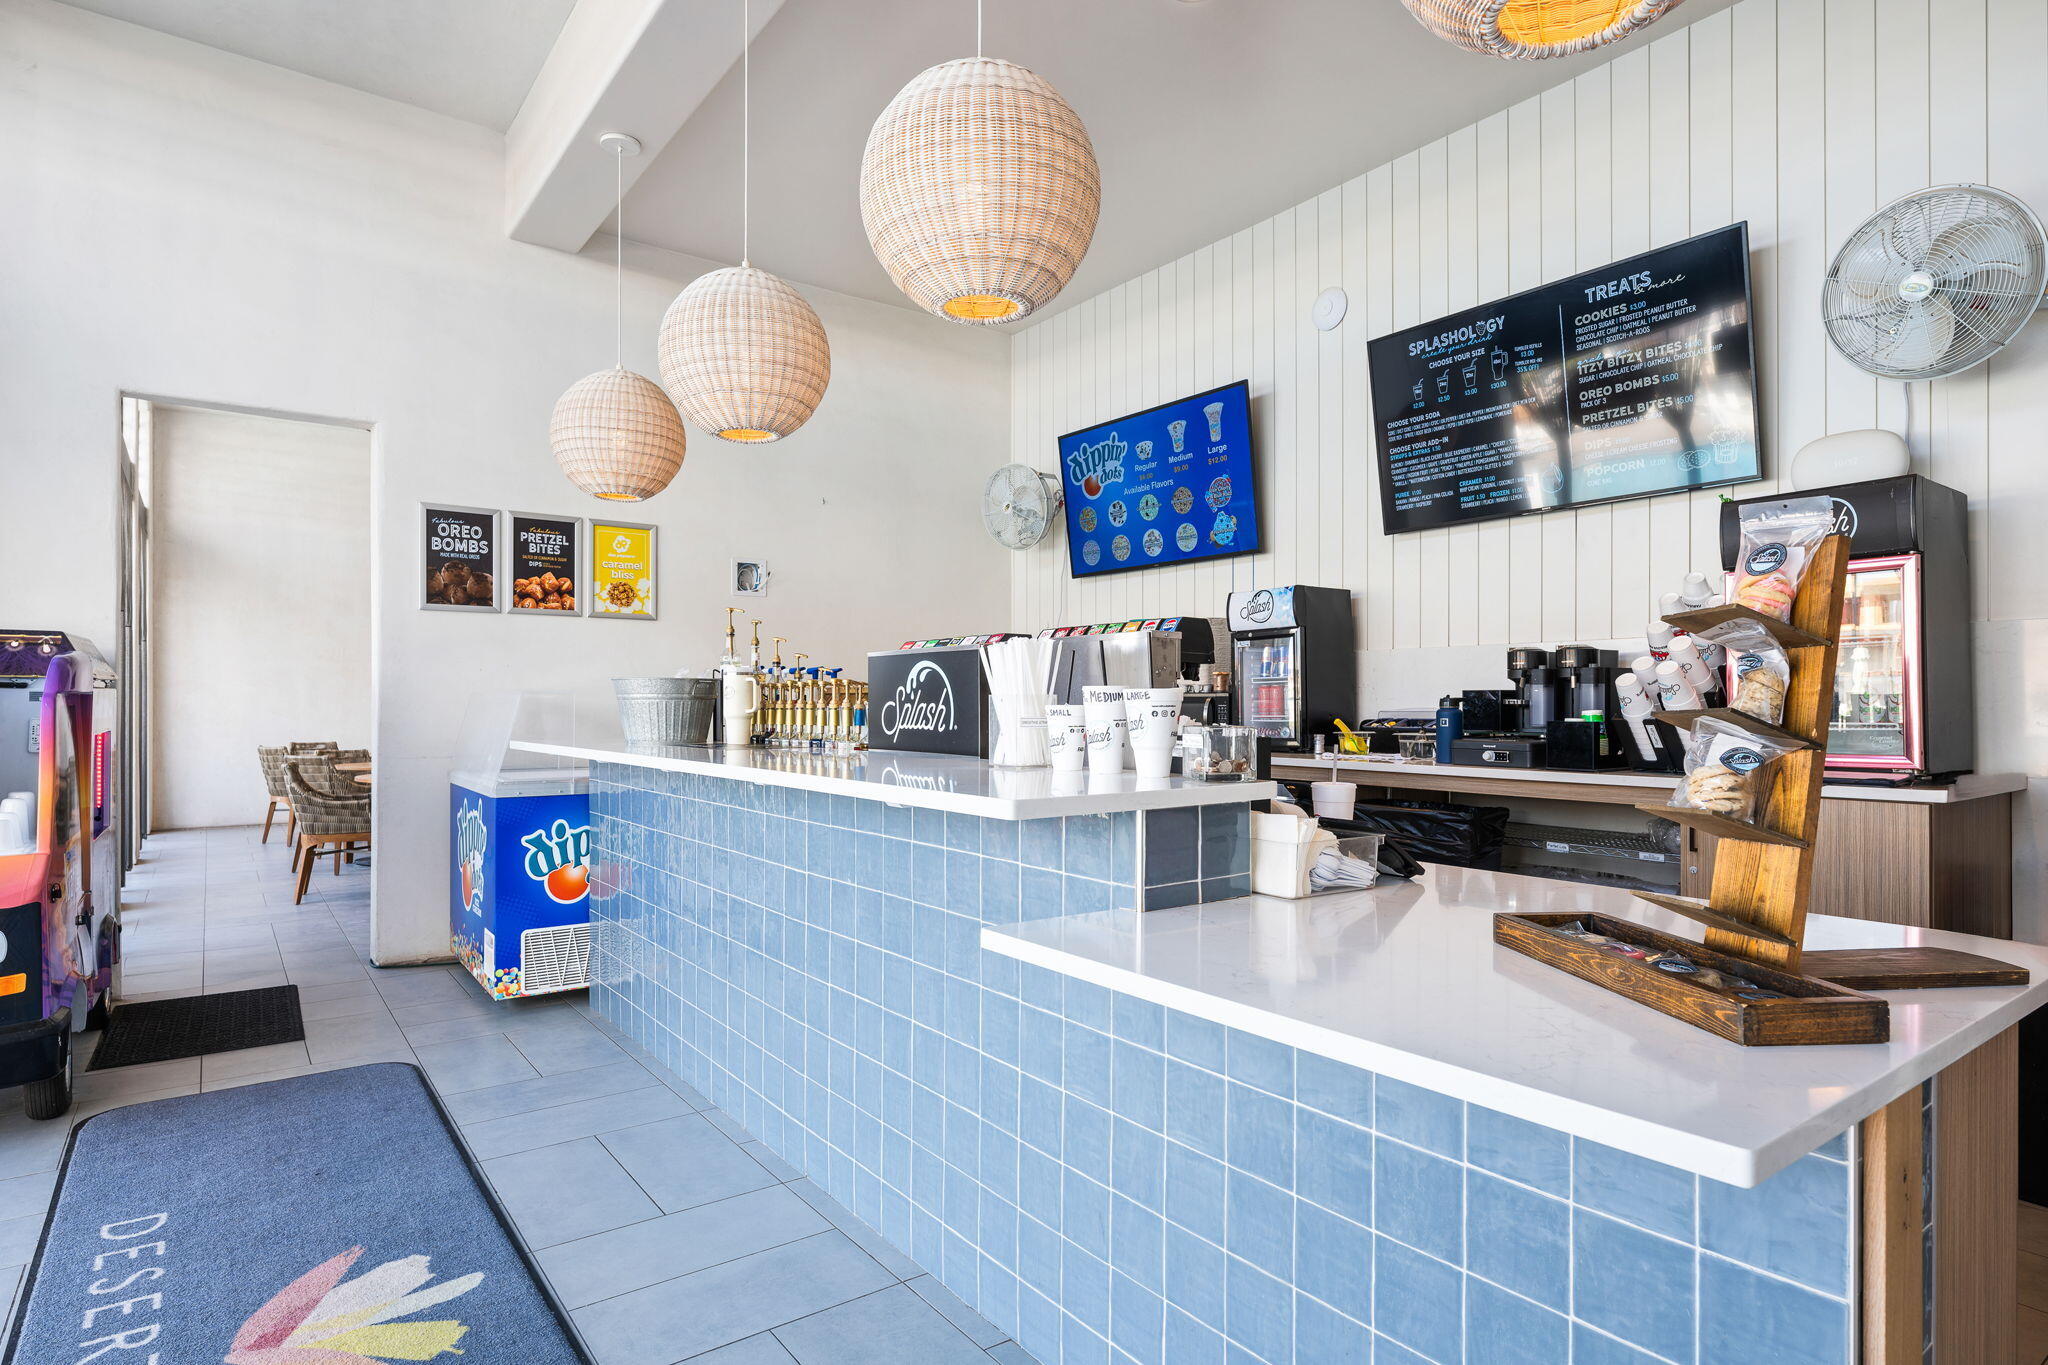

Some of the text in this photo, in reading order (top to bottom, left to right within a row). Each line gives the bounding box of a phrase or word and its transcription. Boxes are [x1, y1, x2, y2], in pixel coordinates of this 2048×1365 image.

[1584, 269, 1652, 304] TREATS
[1633, 271, 1685, 295] & more
[1574, 300, 1646, 326] COOKIES $3.00
[1575, 298, 1687, 335] FROSTED SUGAR FROSTED PEANUT BUTTER
[1575, 304, 1696, 343] CHOCOLATE CHIP OATMEAL PEANUT BUTTER
[1576, 325, 1650, 351] SEASONAL SCOTCH-A-ROOS
[1428, 346, 1485, 369] CHOOSE YOUR SIZE
[1577, 360, 1603, 375] ITZY
[1606, 350, 1641, 368] BITZY
[1645, 340, 1682, 358] BITES
[1578, 374, 1595, 384] SUGAR
[1598, 366, 1629, 379] CHOCOLATE
[1630, 362, 1642, 371] CHIP
[1647, 355, 1672, 367] OATMEAL
[1673, 347, 1706, 361] CHOCOLATE
[1578, 372, 1678, 401] OREO BOMBS $5.00
[1580, 400, 1593, 408] PACK
[1582, 404, 1634, 424] PRETZEL
[1637, 396, 1672, 413] BITES
[1387, 410, 1440, 428] CHOOSE YOUR SODA
[1207, 444, 1227, 455] Large
[1389, 436, 1448, 454] CHOOSE YOUR ADD-IN
[1584, 437, 1611, 450] DIPS
[1068, 433, 1126, 483] dippin'
[1134, 461, 1158, 472] Regular
[1168, 453, 1193, 464] Medium
[1207, 455, 1228, 465] $12.00
[1099, 467, 1123, 484] dots
[1174, 464, 1189, 474] $9.00
[1586, 458, 1644, 477] POPCORN
[1123, 478, 1174, 496] Available Flavors
[1459, 478, 1482, 486] CREAMER
[1489, 489, 1509, 497] FROZEN
[437, 523, 483, 540] OREO
[520, 532, 569, 546] PRETZEL
[431, 537, 489, 554] BOMBS
[528, 543, 561, 555] BITES
[602, 560, 643, 571] caramel
[611, 571, 635, 579] bliss
[1240, 596, 1271, 622] Splash
[1089, 690, 1124, 704] MEDIUM
[1126, 691, 1151, 701] LARGE
[881, 686, 948, 743] Splash
[1050, 709, 1072, 717] SMALL
[522, 820, 590, 879] dip
[75, 1212, 168, 1365] DESER
